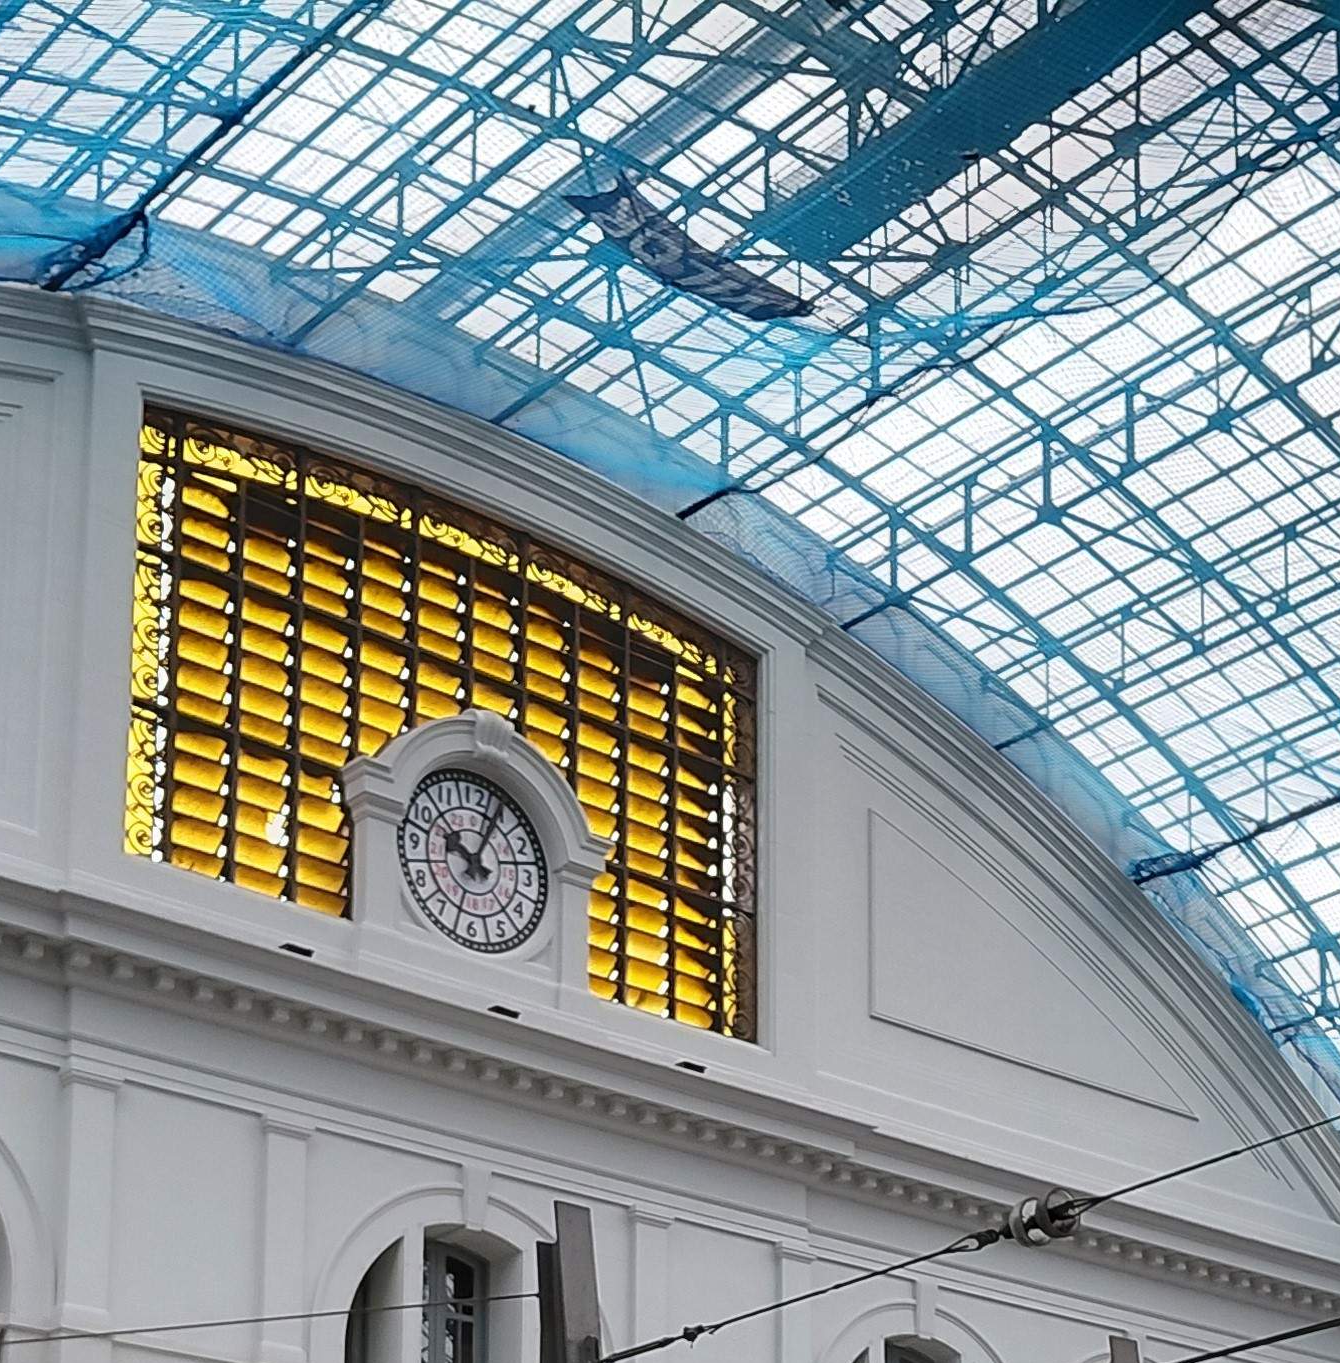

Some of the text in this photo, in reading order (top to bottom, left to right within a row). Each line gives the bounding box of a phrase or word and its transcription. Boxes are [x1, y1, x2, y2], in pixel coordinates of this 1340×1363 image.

[438, 785, 451, 806] 11
[466, 785, 487, 808] 12
[415, 802, 432, 824] 10
[409, 832, 420, 850] 9
[517, 837, 528, 856] 2
[416, 869, 426, 887] 8
[523, 869, 532, 888] 3
[436, 899, 447, 917] 7
[513, 901, 523, 919] 4
[467, 921, 477, 938] 6
[495, 920, 506, 938] 5
